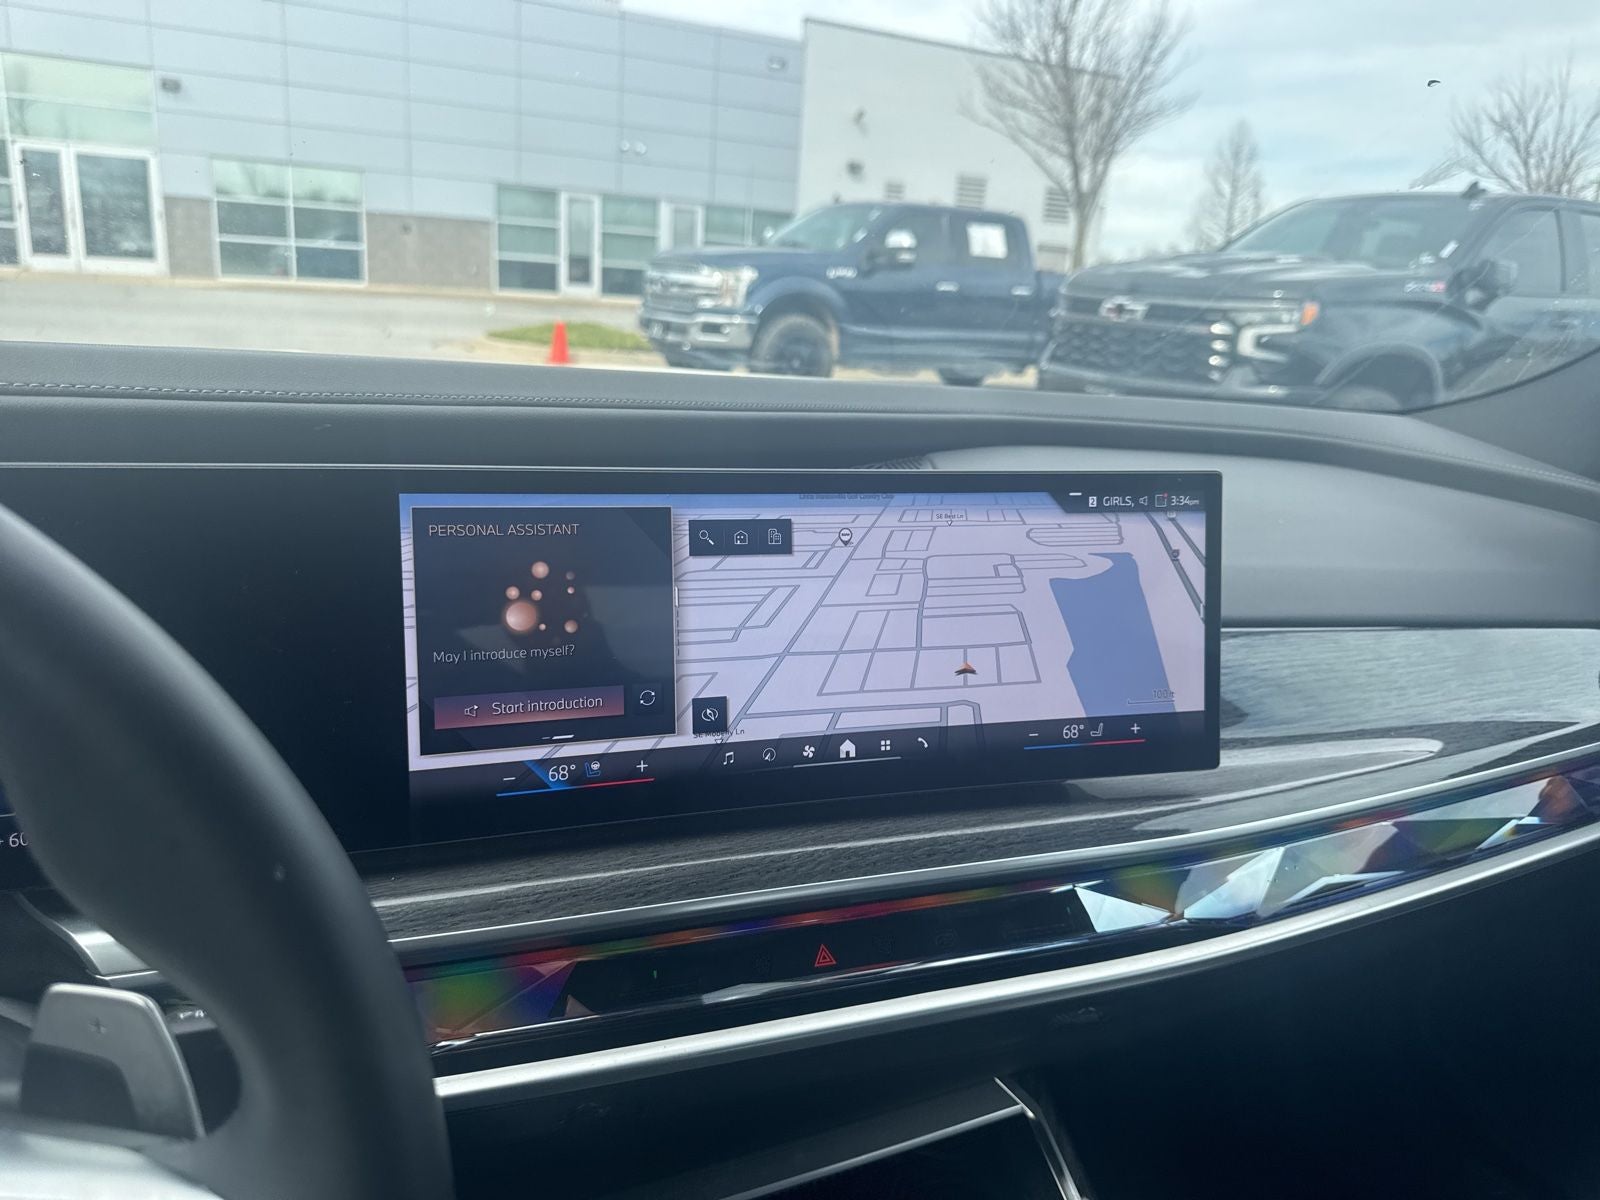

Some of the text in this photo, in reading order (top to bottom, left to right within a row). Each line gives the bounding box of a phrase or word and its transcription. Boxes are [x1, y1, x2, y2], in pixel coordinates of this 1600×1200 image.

[428, 523, 580, 537] PERSONAL ASSISTANT
[433, 651, 460, 664] May
[470, 648, 527, 661] introduce
[531, 645, 575, 660] myself?
[492, 696, 603, 715] Start introduction
